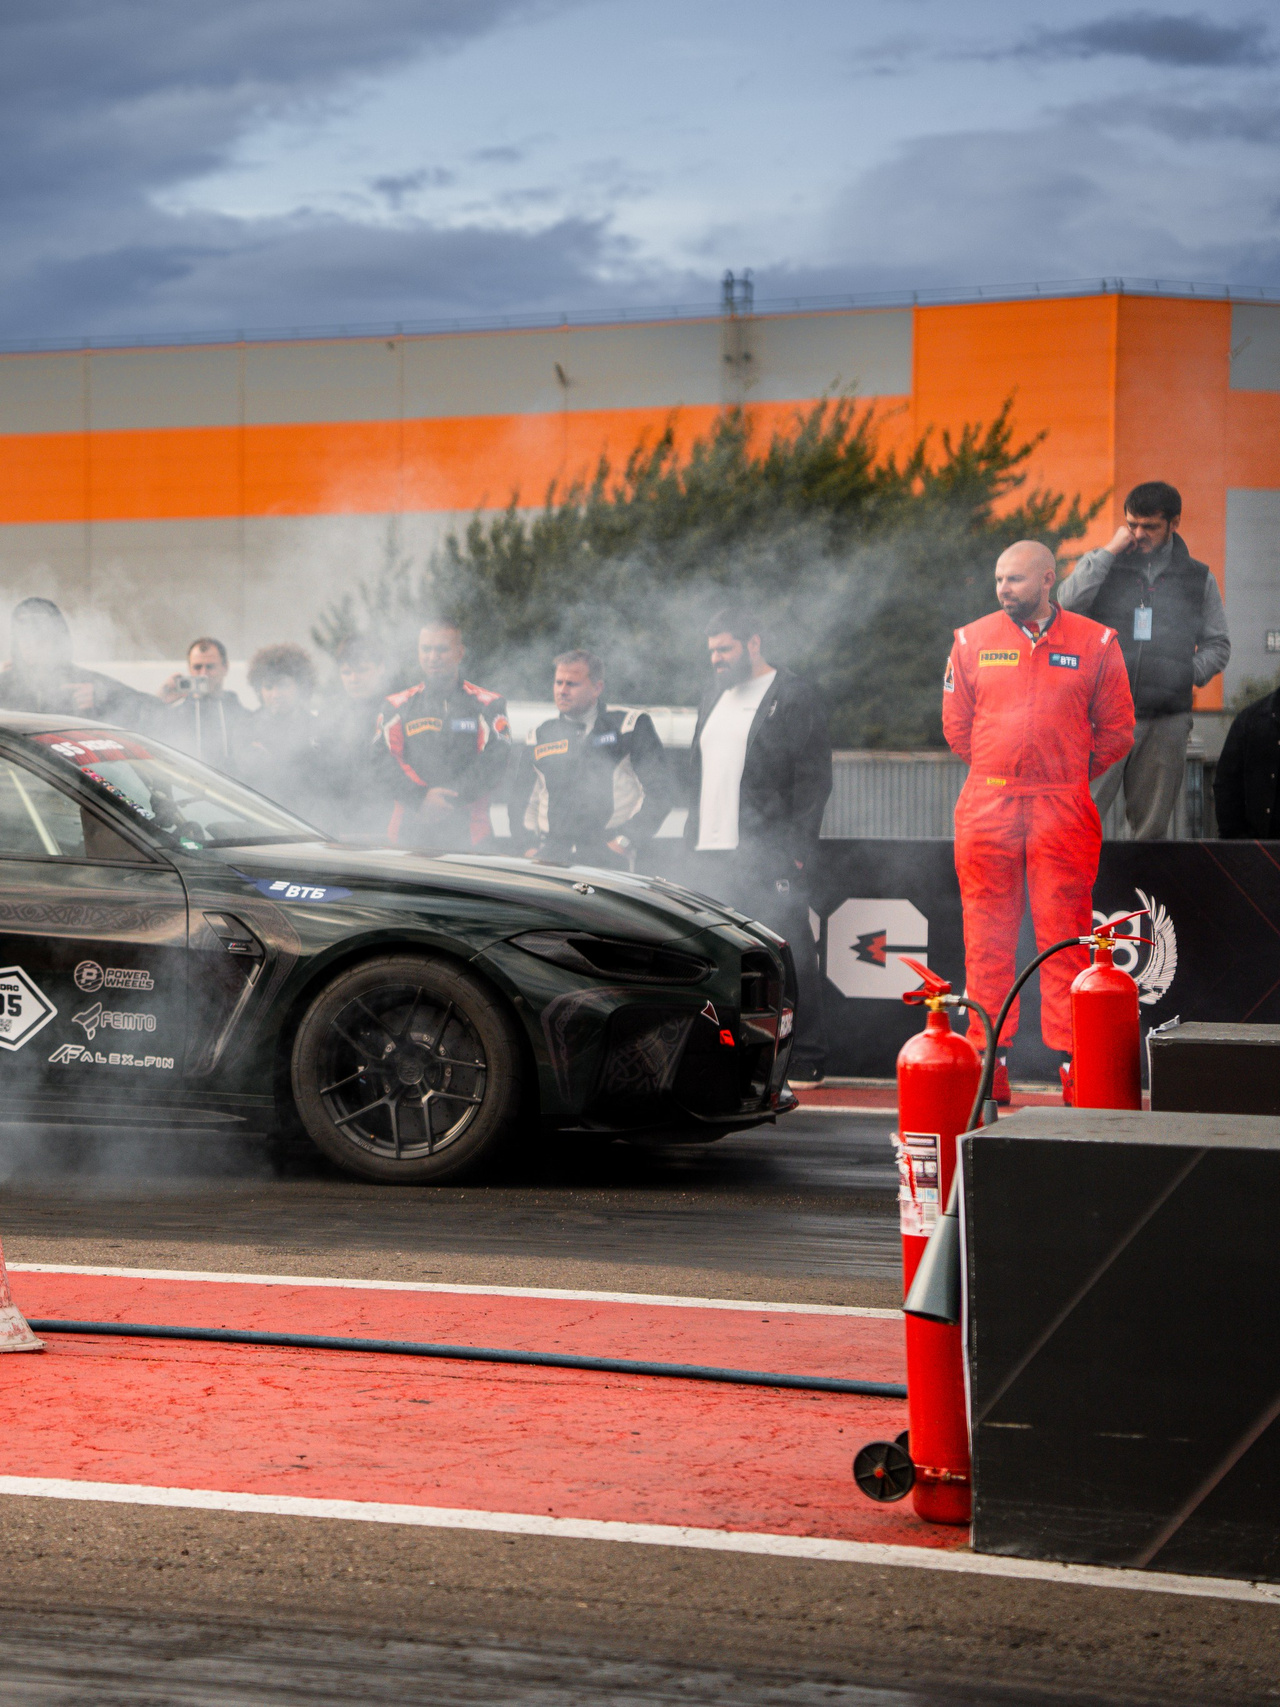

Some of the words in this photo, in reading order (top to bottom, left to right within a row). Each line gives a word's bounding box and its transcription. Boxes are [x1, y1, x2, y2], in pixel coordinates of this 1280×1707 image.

[285, 884, 327, 899] ВТБ
[106, 969, 149, 980] POWER
[101, 1011, 156, 1032] FEMTO
